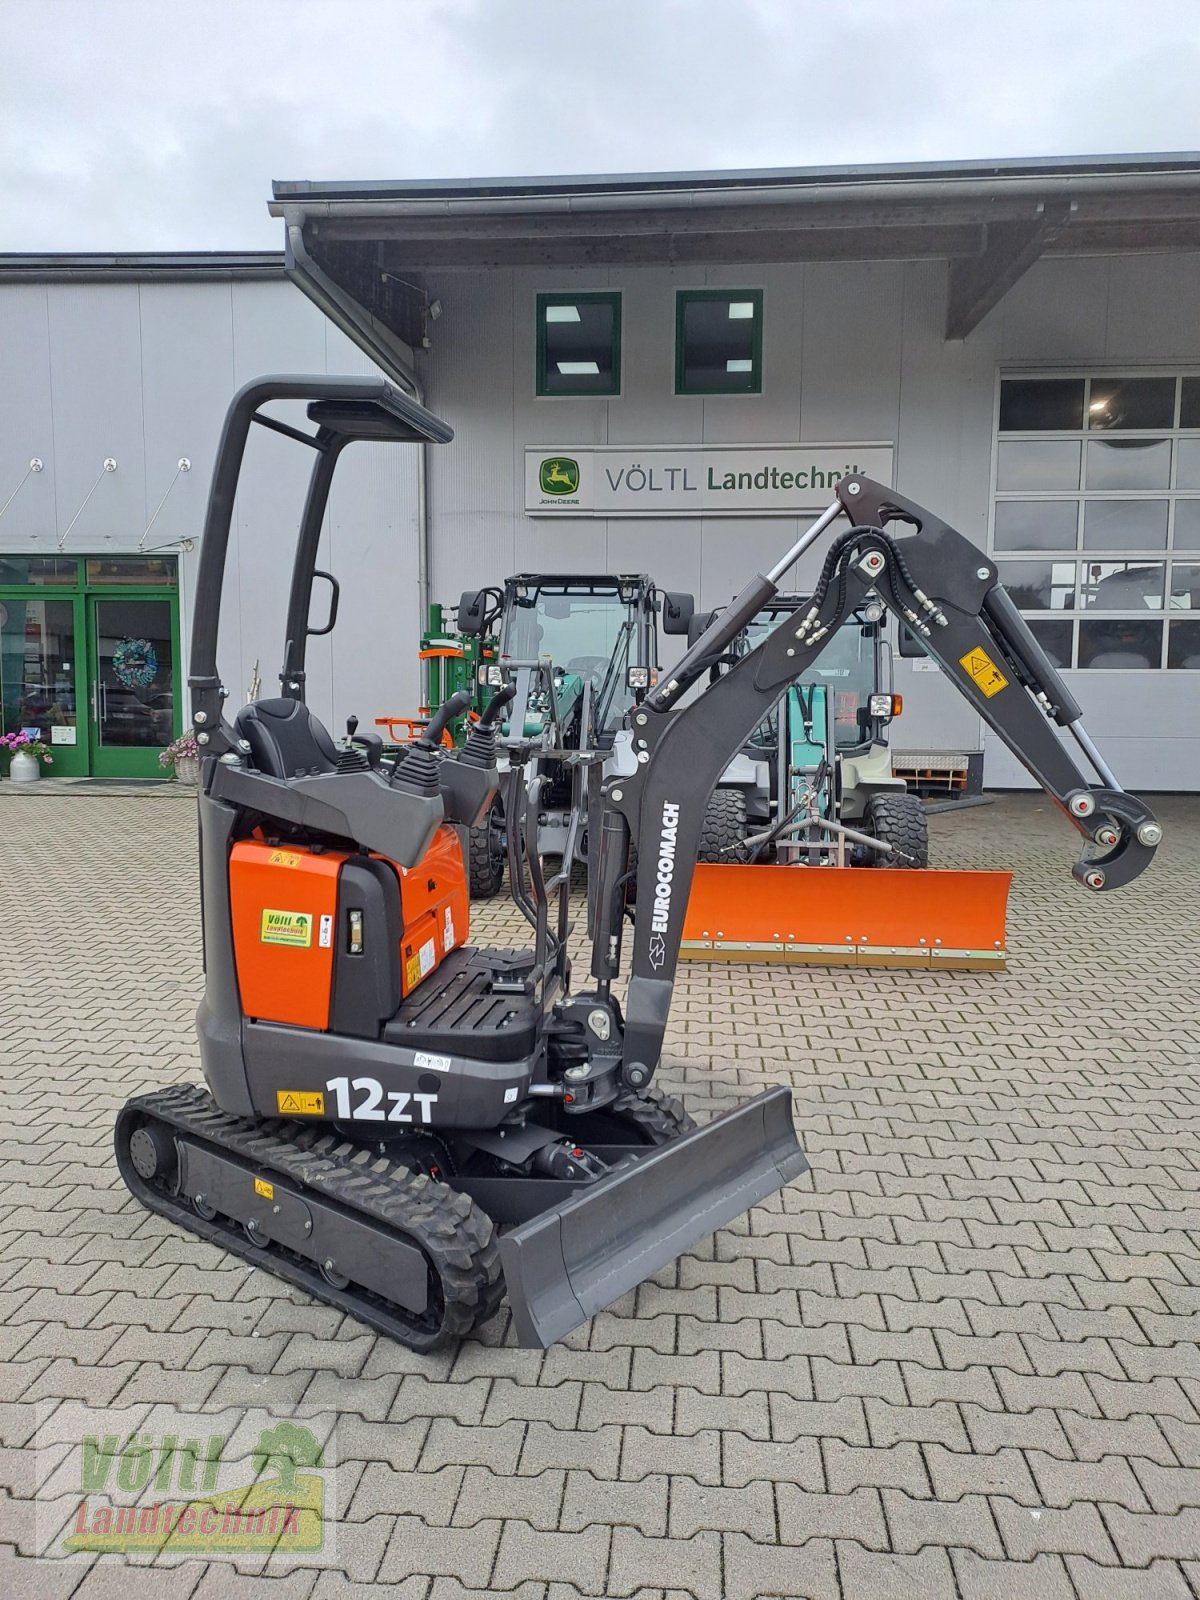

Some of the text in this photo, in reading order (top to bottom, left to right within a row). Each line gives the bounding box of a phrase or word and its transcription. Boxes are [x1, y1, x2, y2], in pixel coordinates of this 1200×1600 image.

[605, 463, 698, 492] VÖLTL
[651, 803, 680, 933] EUROCOMACH
[325, 1076, 439, 1124] 12ZT
